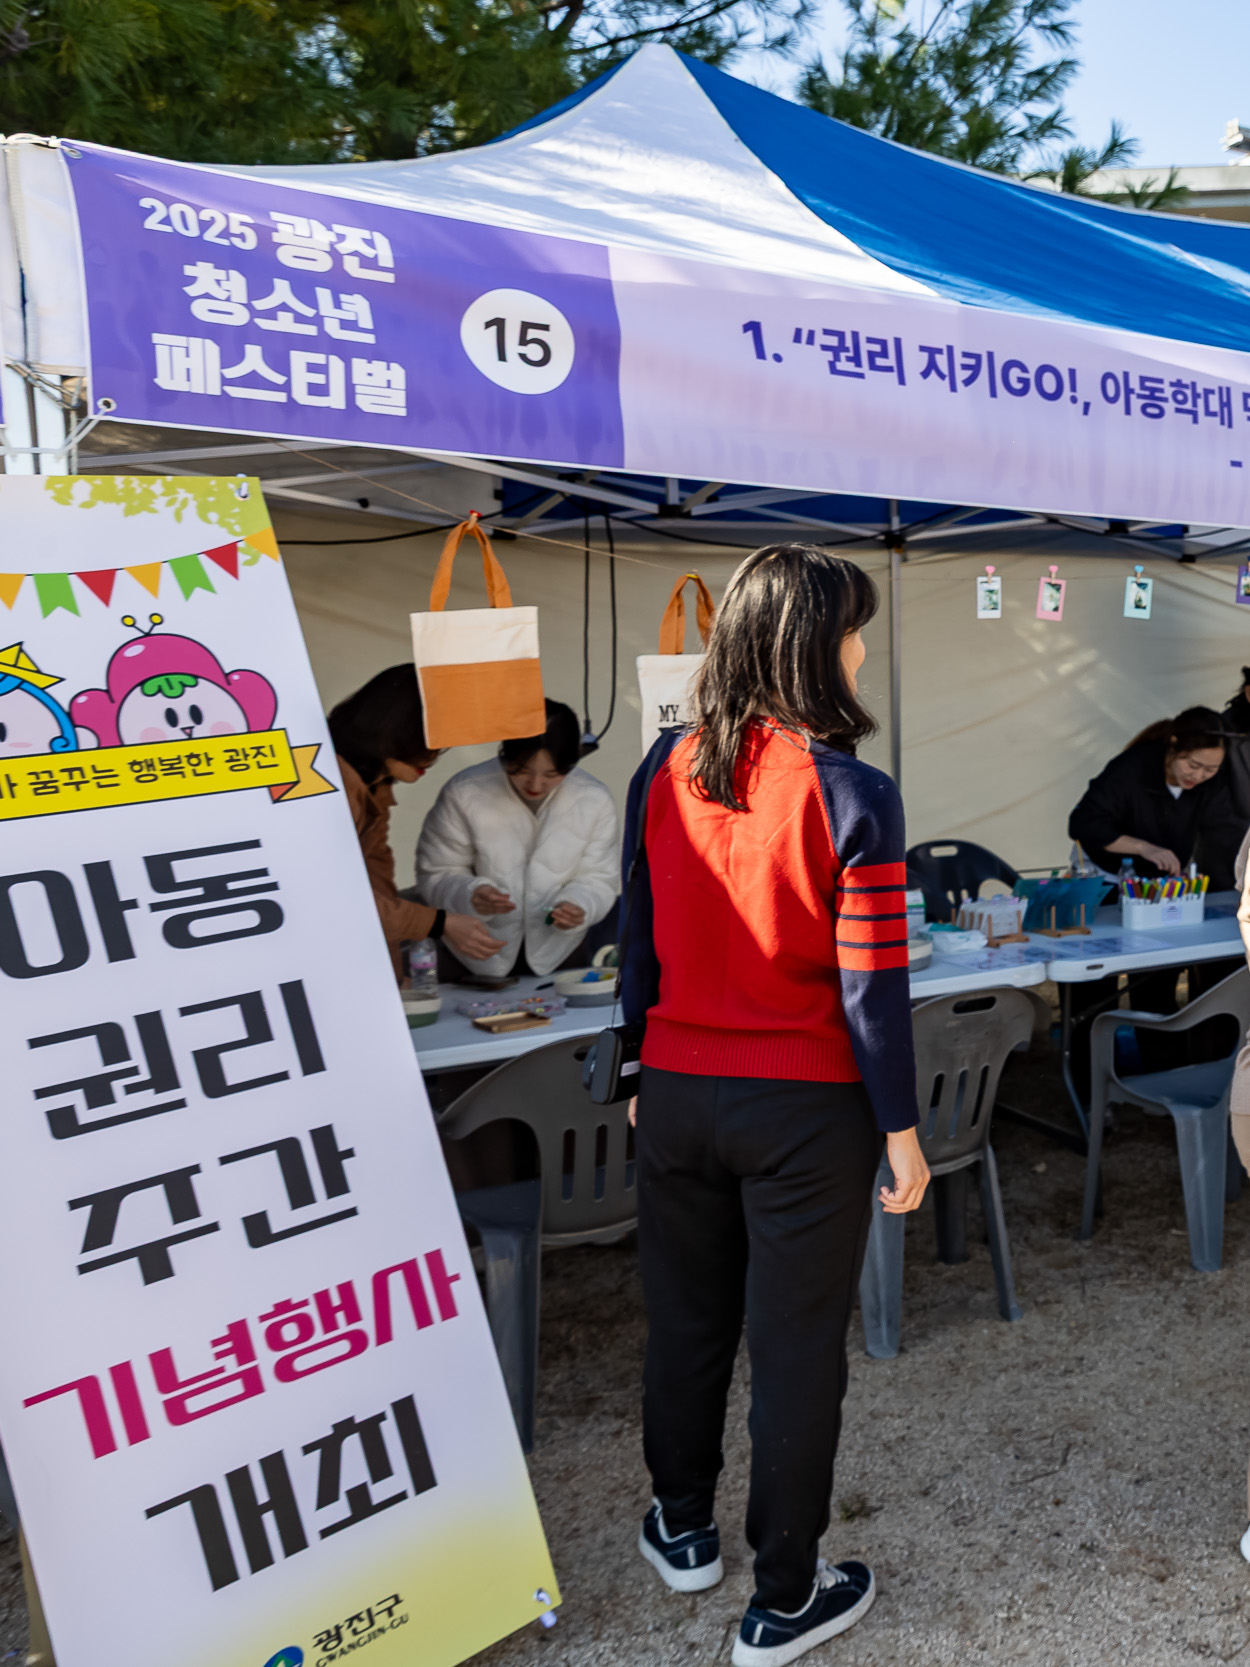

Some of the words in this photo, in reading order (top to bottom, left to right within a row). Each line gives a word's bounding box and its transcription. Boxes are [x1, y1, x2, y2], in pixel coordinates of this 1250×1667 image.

[138, 197, 258, 251] 2025
[270, 211, 396, 283] 광진
[182, 262, 377, 344] 청소년
[483, 317, 552, 368] 15
[152, 333, 409, 416] 페스티벌
[741, 320, 783, 363] 1.
[918, 345, 1091, 416] 지키GO!,
[1100, 371, 1234, 429] 아동학대
[658, 704, 680, 722] MY
[27, 763, 120, 797] 꿈꾸는
[127, 750, 214, 784] 행복한
[223, 743, 280, 774] 광진
[0, 838, 285, 980] 아동
[27, 978, 327, 1141] 권리
[68, 1123, 359, 1287] 주간
[22, 1248, 462, 1460] 기념행사
[144, 1393, 438, 1594] 개최
[312, 1593, 404, 1652] 광진구
